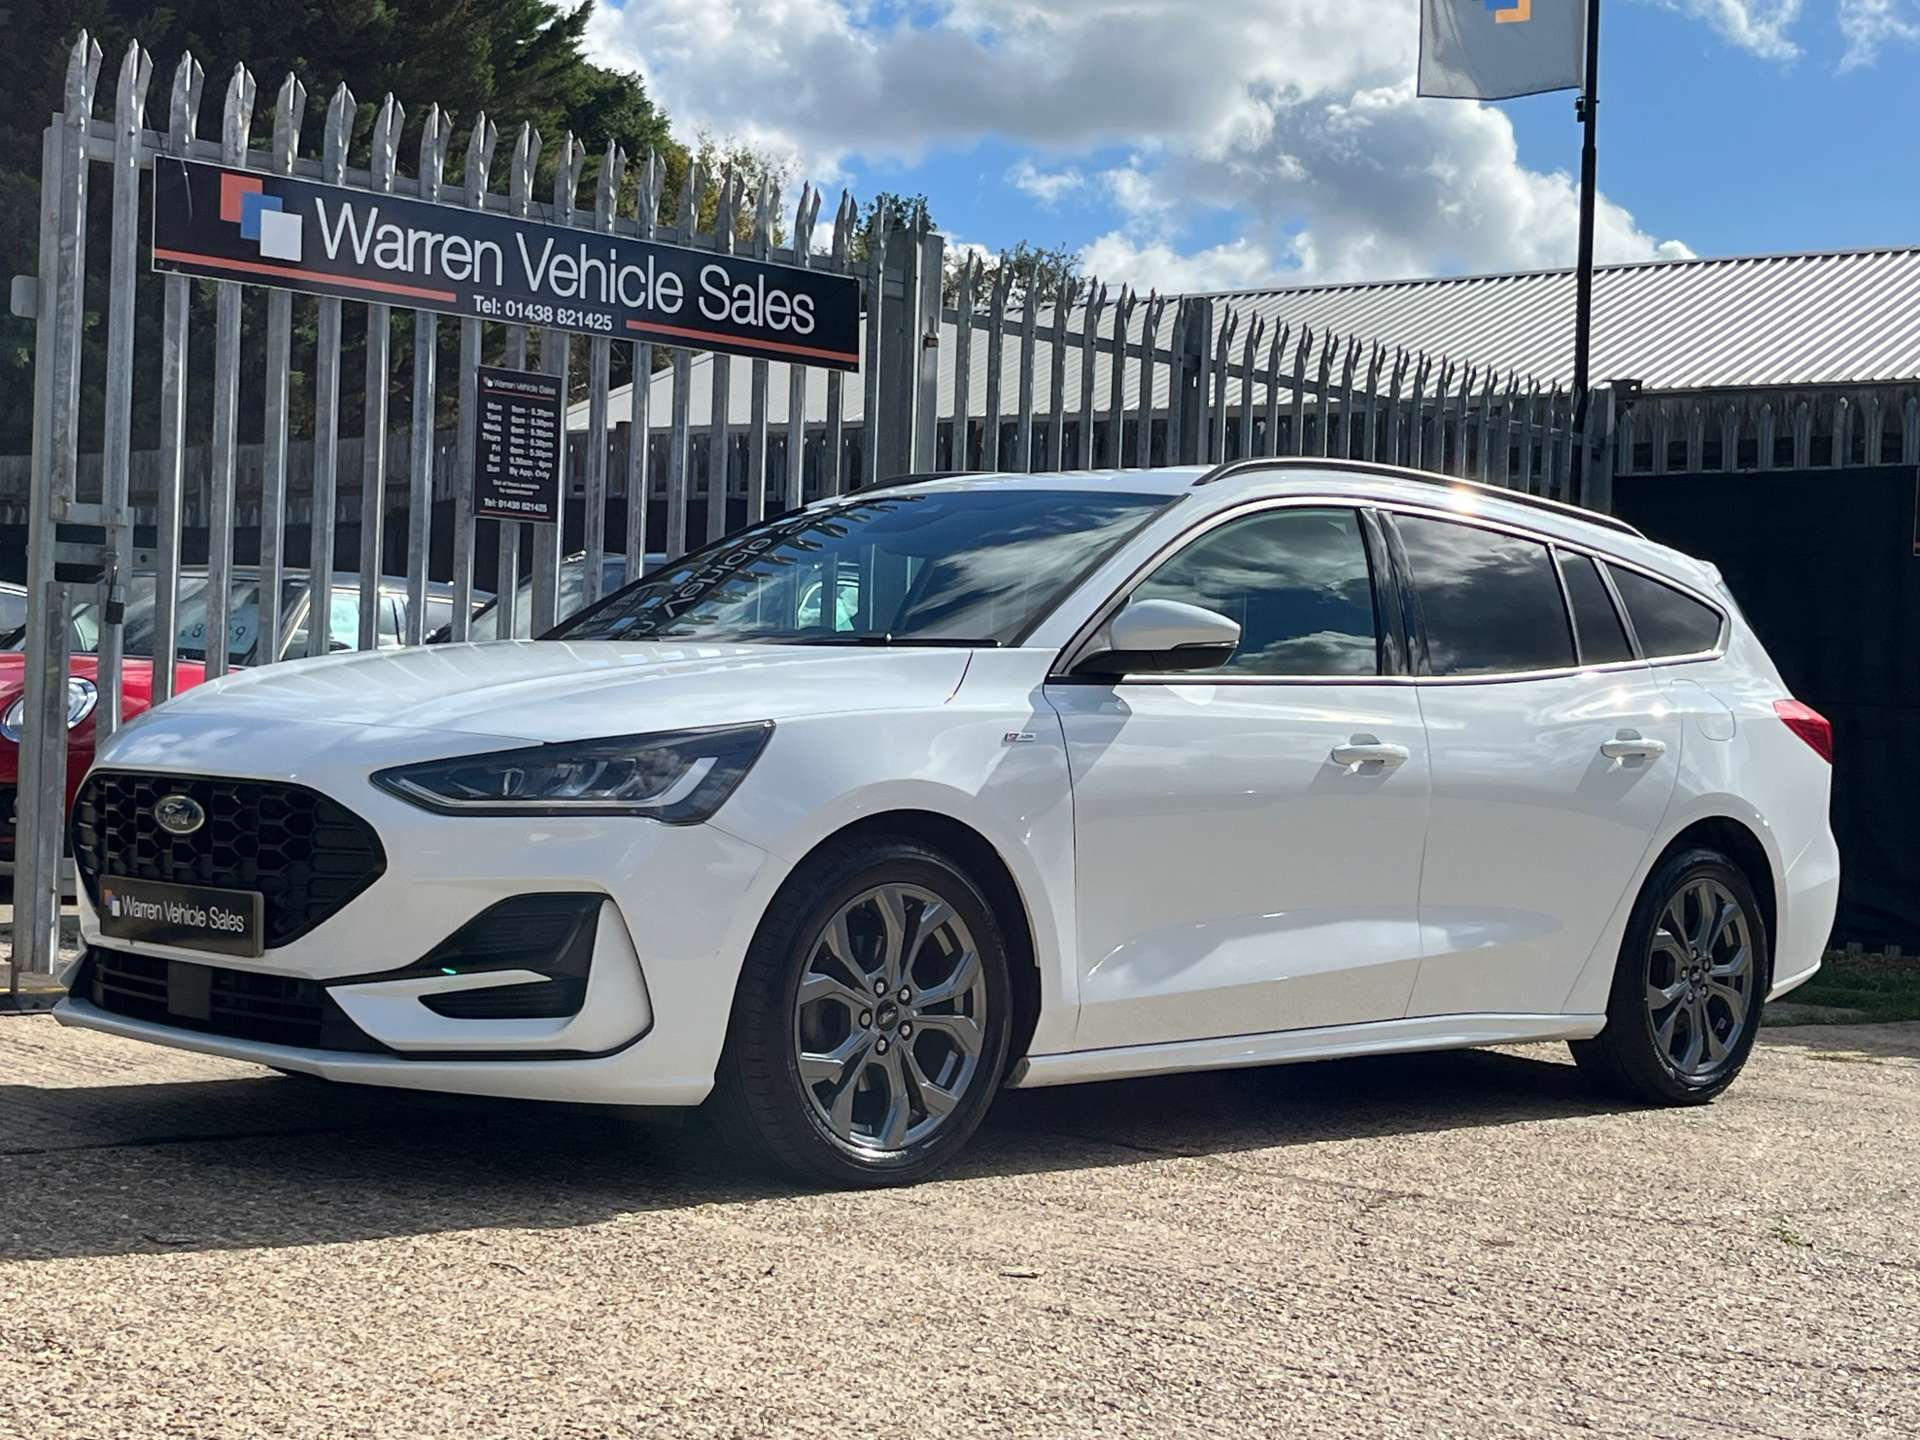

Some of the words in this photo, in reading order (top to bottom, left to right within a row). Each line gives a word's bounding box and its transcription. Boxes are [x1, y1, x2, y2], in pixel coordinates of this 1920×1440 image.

[315, 197, 503, 287] Warren
[515, 232, 684, 314] Vehicle
[698, 263, 815, 335] Sales
[473, 294, 501, 315] Tel:
[505, 299, 553, 323] 01438
[556, 307, 613, 332] 821425
[121, 895, 163, 921] Warren
[164, 901, 206, 928] Vehicle
[209, 906, 245, 933] Sales
